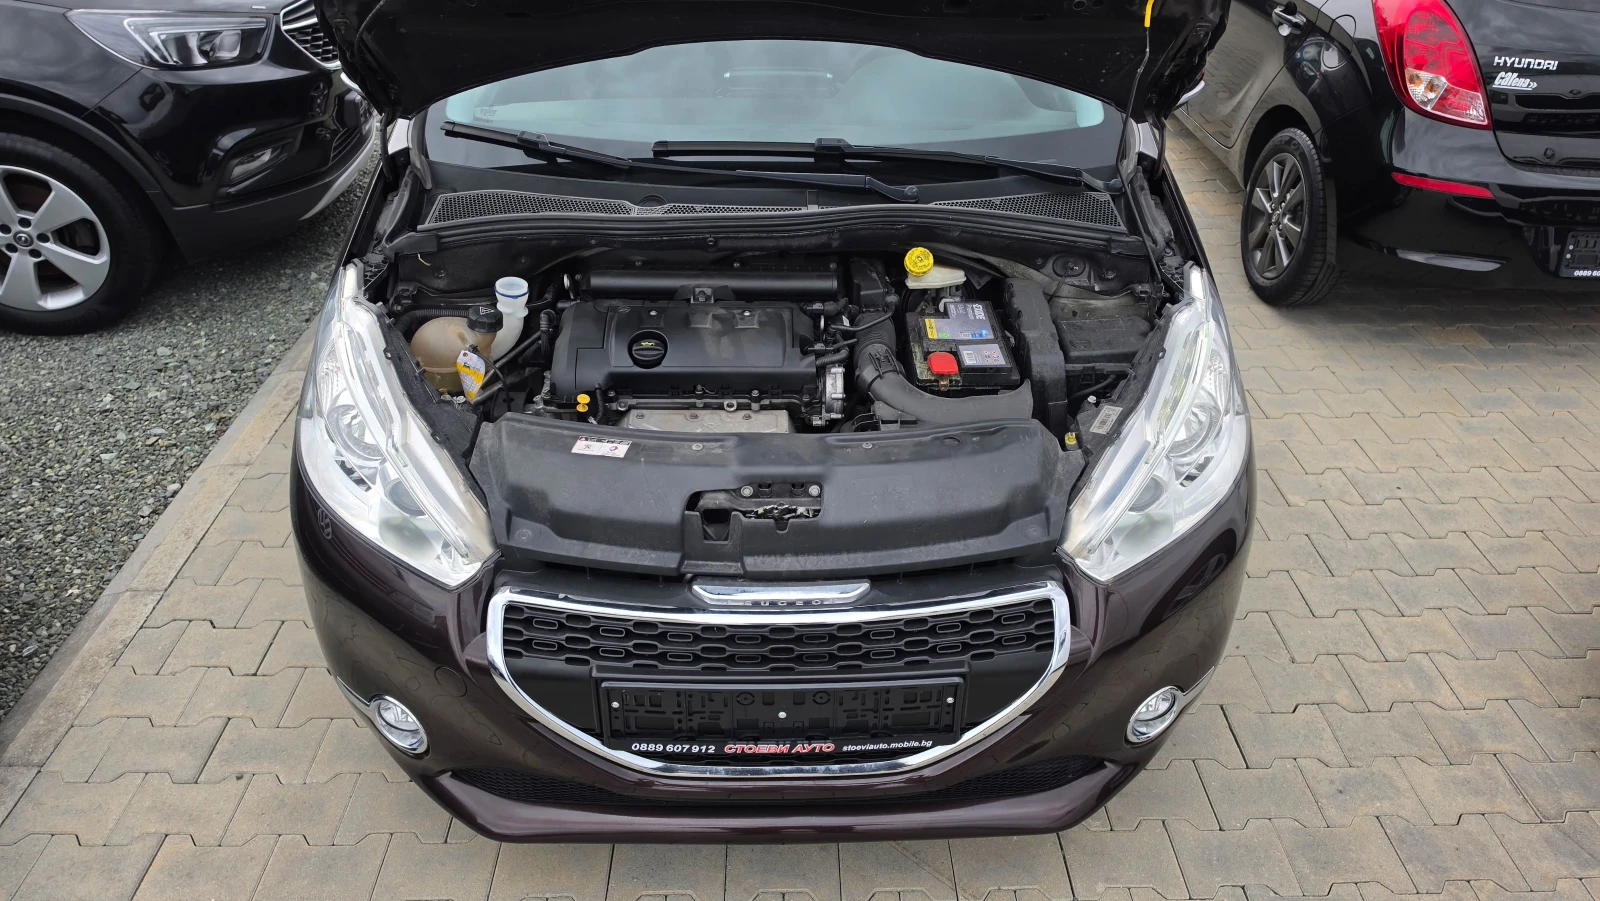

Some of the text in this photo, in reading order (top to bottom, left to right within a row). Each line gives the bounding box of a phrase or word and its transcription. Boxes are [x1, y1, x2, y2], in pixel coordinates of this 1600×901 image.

[1493, 56, 1558, 70] HYUNDAI
[631, 740, 933, 754] 0889 607 912 СТОЕВИ АУТО stoeviauto.mobile.bg
